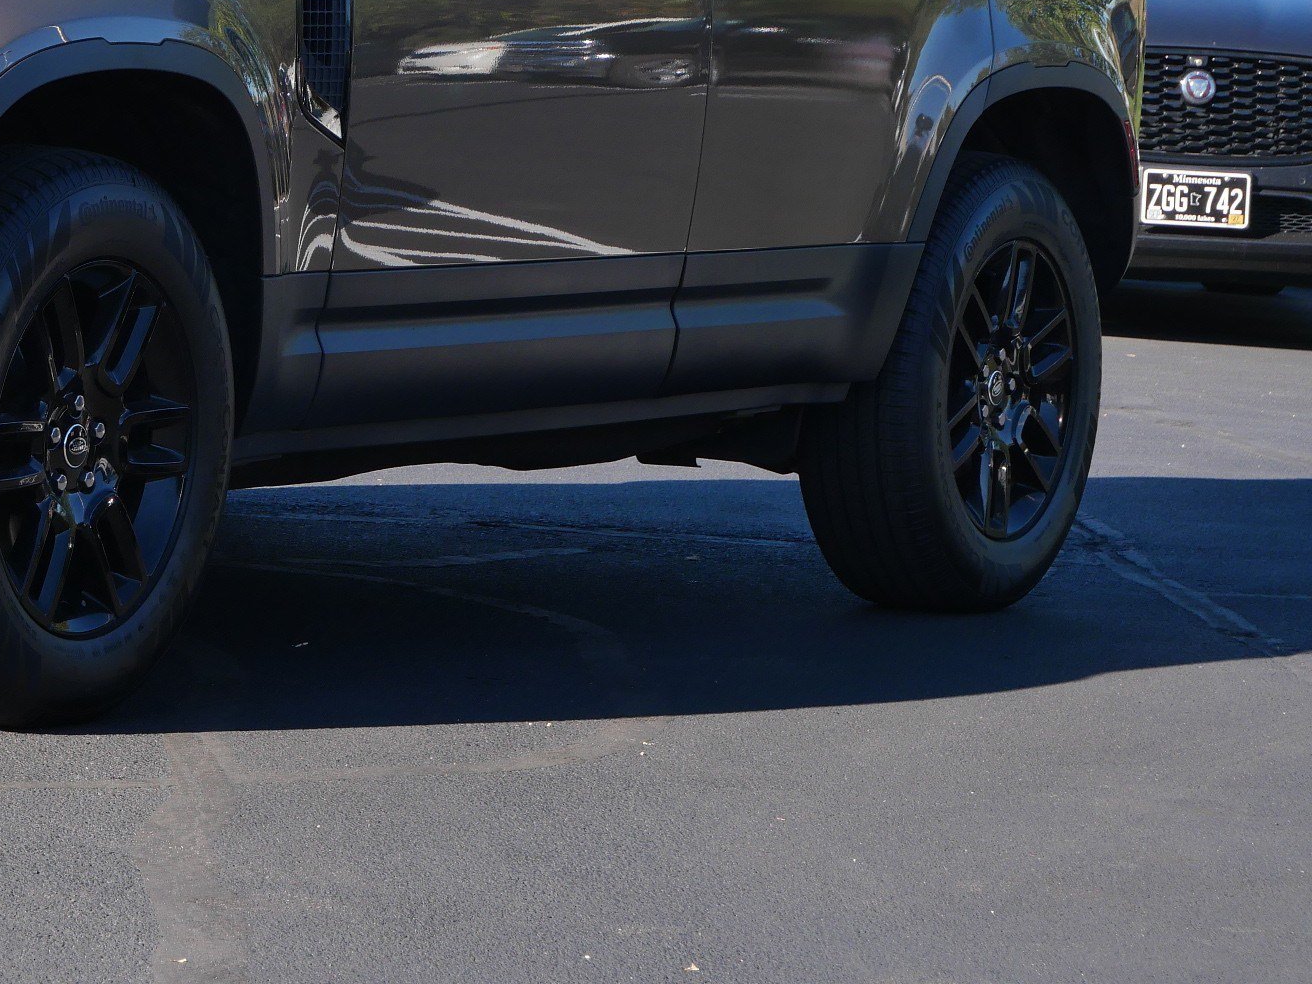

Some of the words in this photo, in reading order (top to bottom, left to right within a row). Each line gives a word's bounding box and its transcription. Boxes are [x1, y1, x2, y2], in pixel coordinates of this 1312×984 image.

[1172, 174, 1222, 186] Minnesota
[1148, 183, 1189, 212] ZGG
[1203, 186, 1244, 215] 742
[963, 196, 1007, 262] Continental
